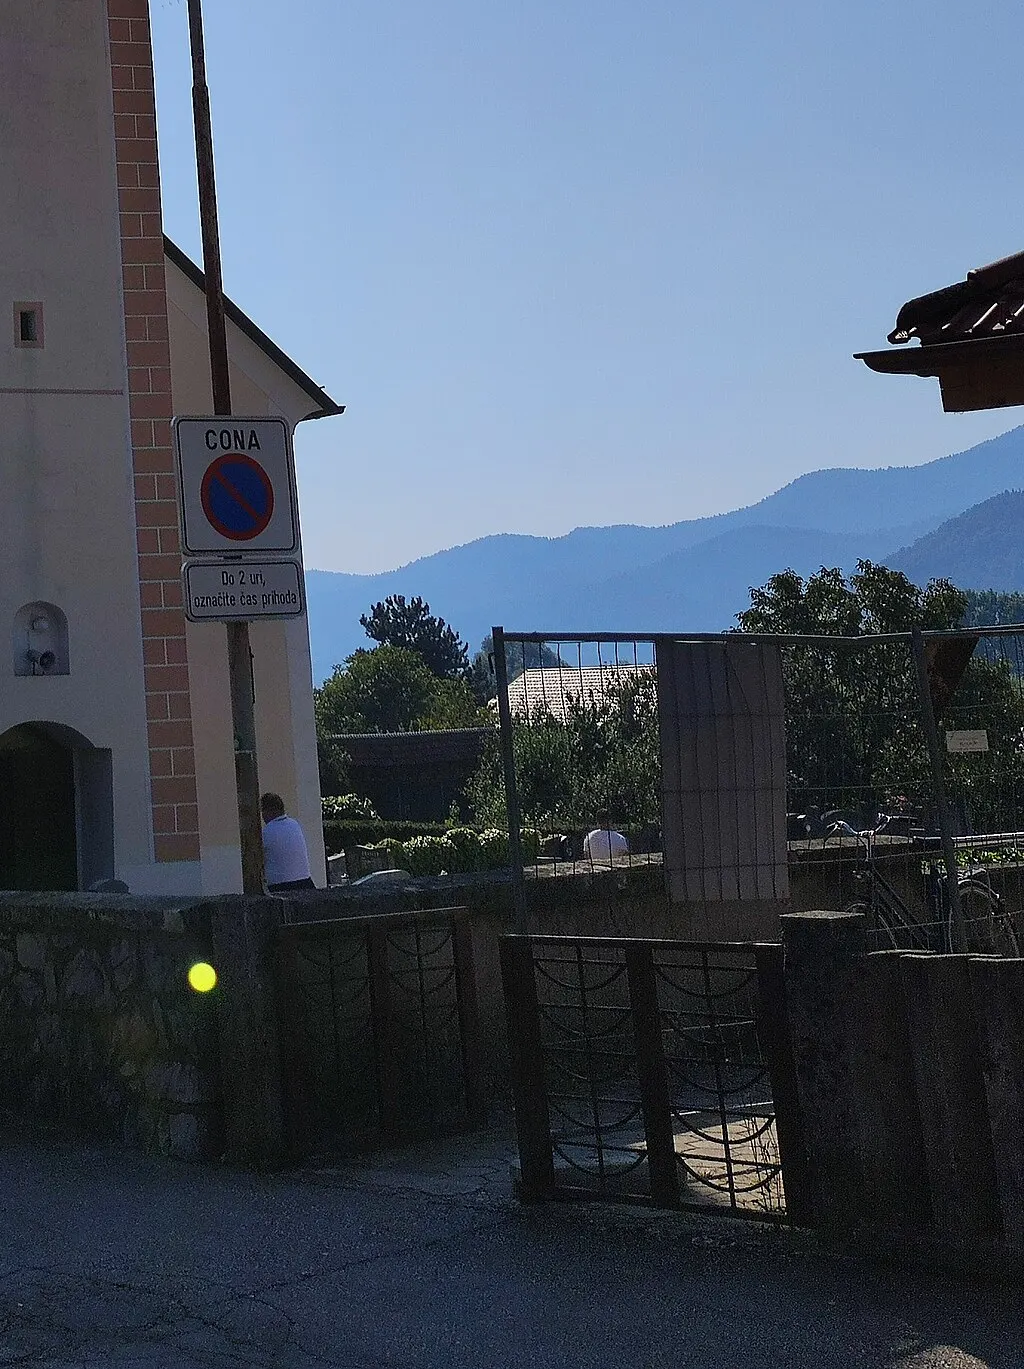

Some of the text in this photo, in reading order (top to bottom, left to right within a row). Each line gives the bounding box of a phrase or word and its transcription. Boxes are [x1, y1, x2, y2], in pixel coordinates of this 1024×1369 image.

[204, 429, 261, 451] CONA
[221, 570, 266, 587] Do 2 uri,
[194, 589, 297, 609] označite čas prihoda
